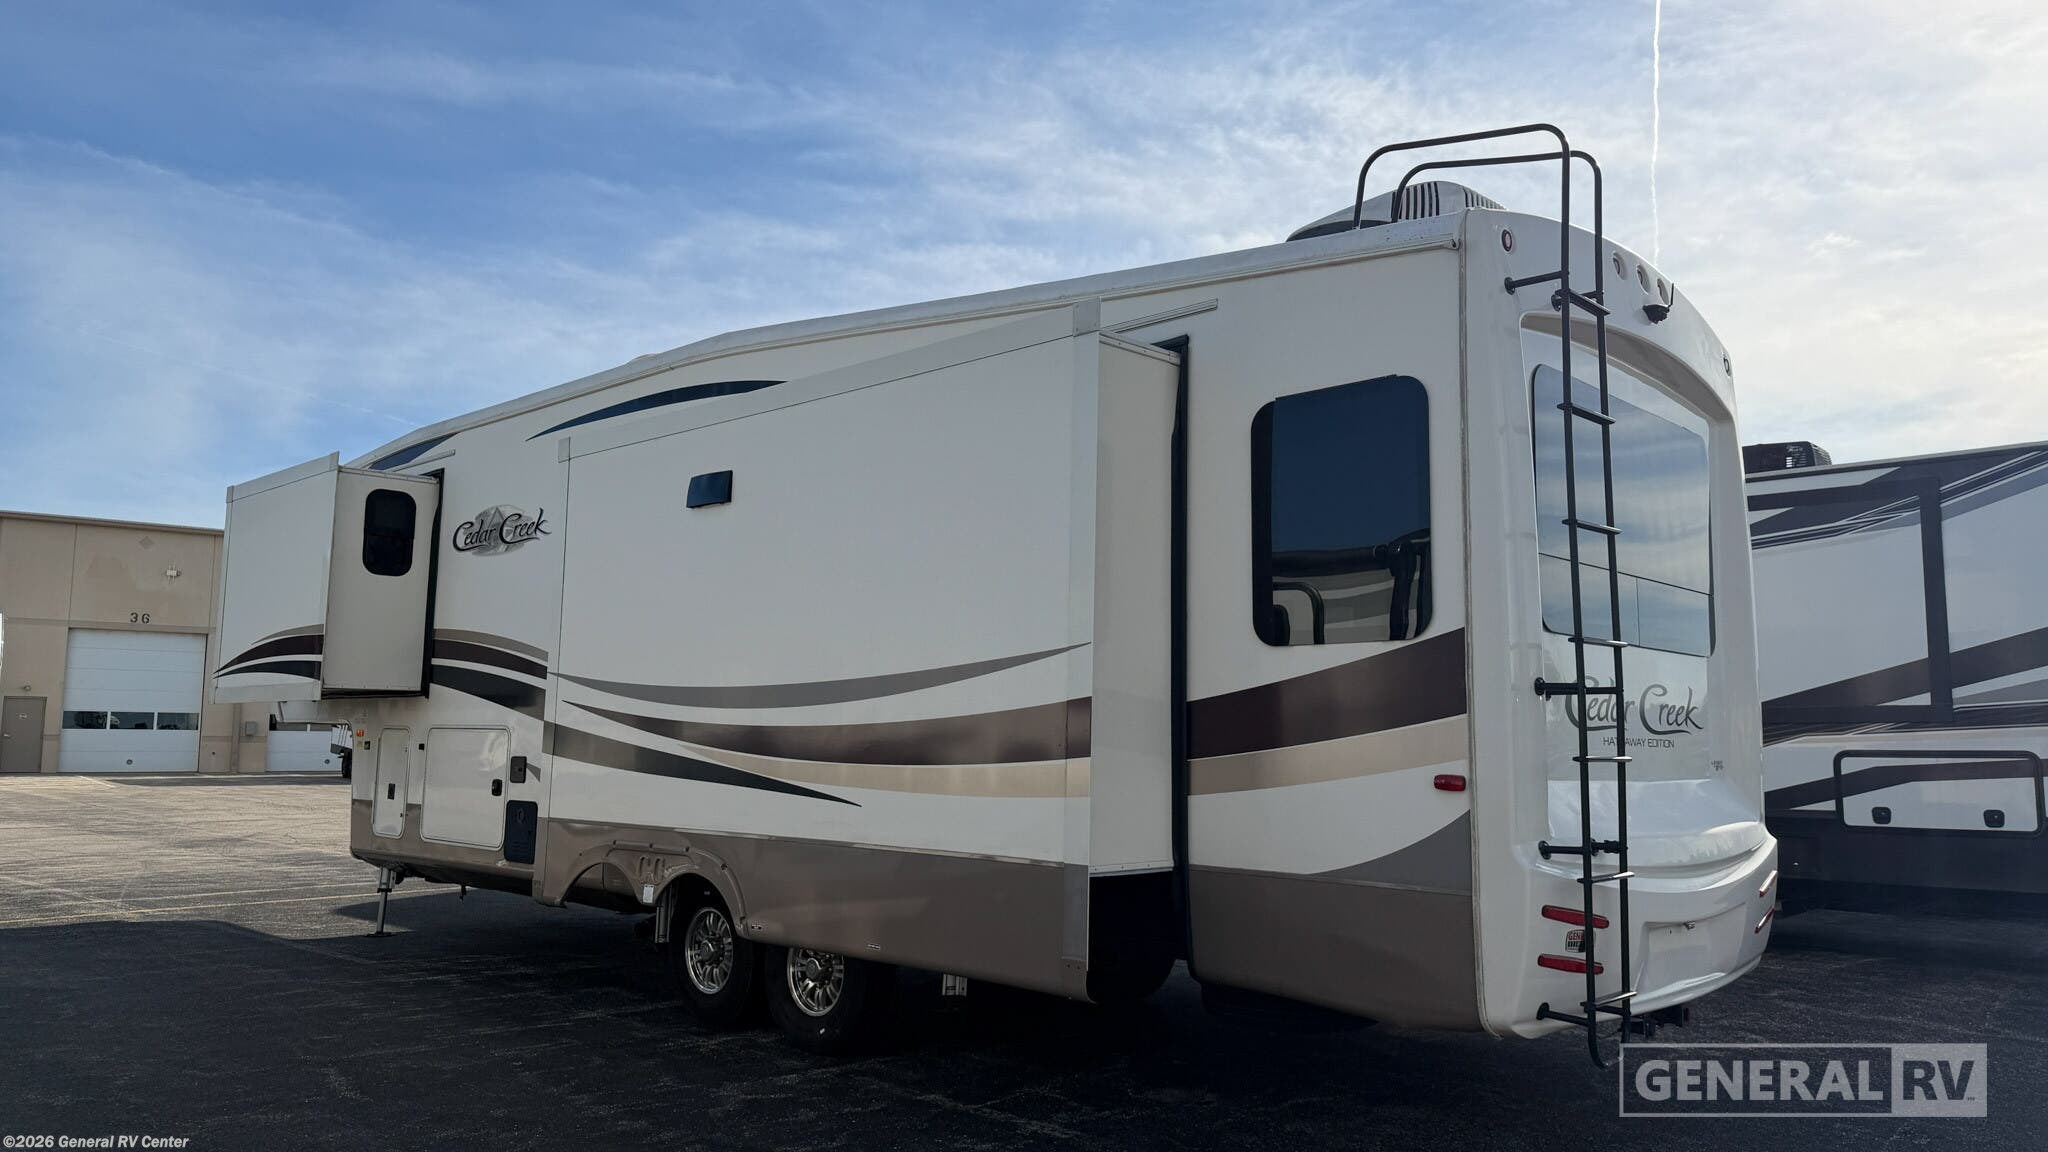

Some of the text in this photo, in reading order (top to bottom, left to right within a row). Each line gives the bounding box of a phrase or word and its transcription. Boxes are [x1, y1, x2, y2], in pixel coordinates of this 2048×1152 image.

[453, 507, 552, 552] Cedar Creek
[130, 612, 151, 624] 36
[1639, 683, 1704, 735] Creek
[1647, 738, 1675, 748] EDITION
